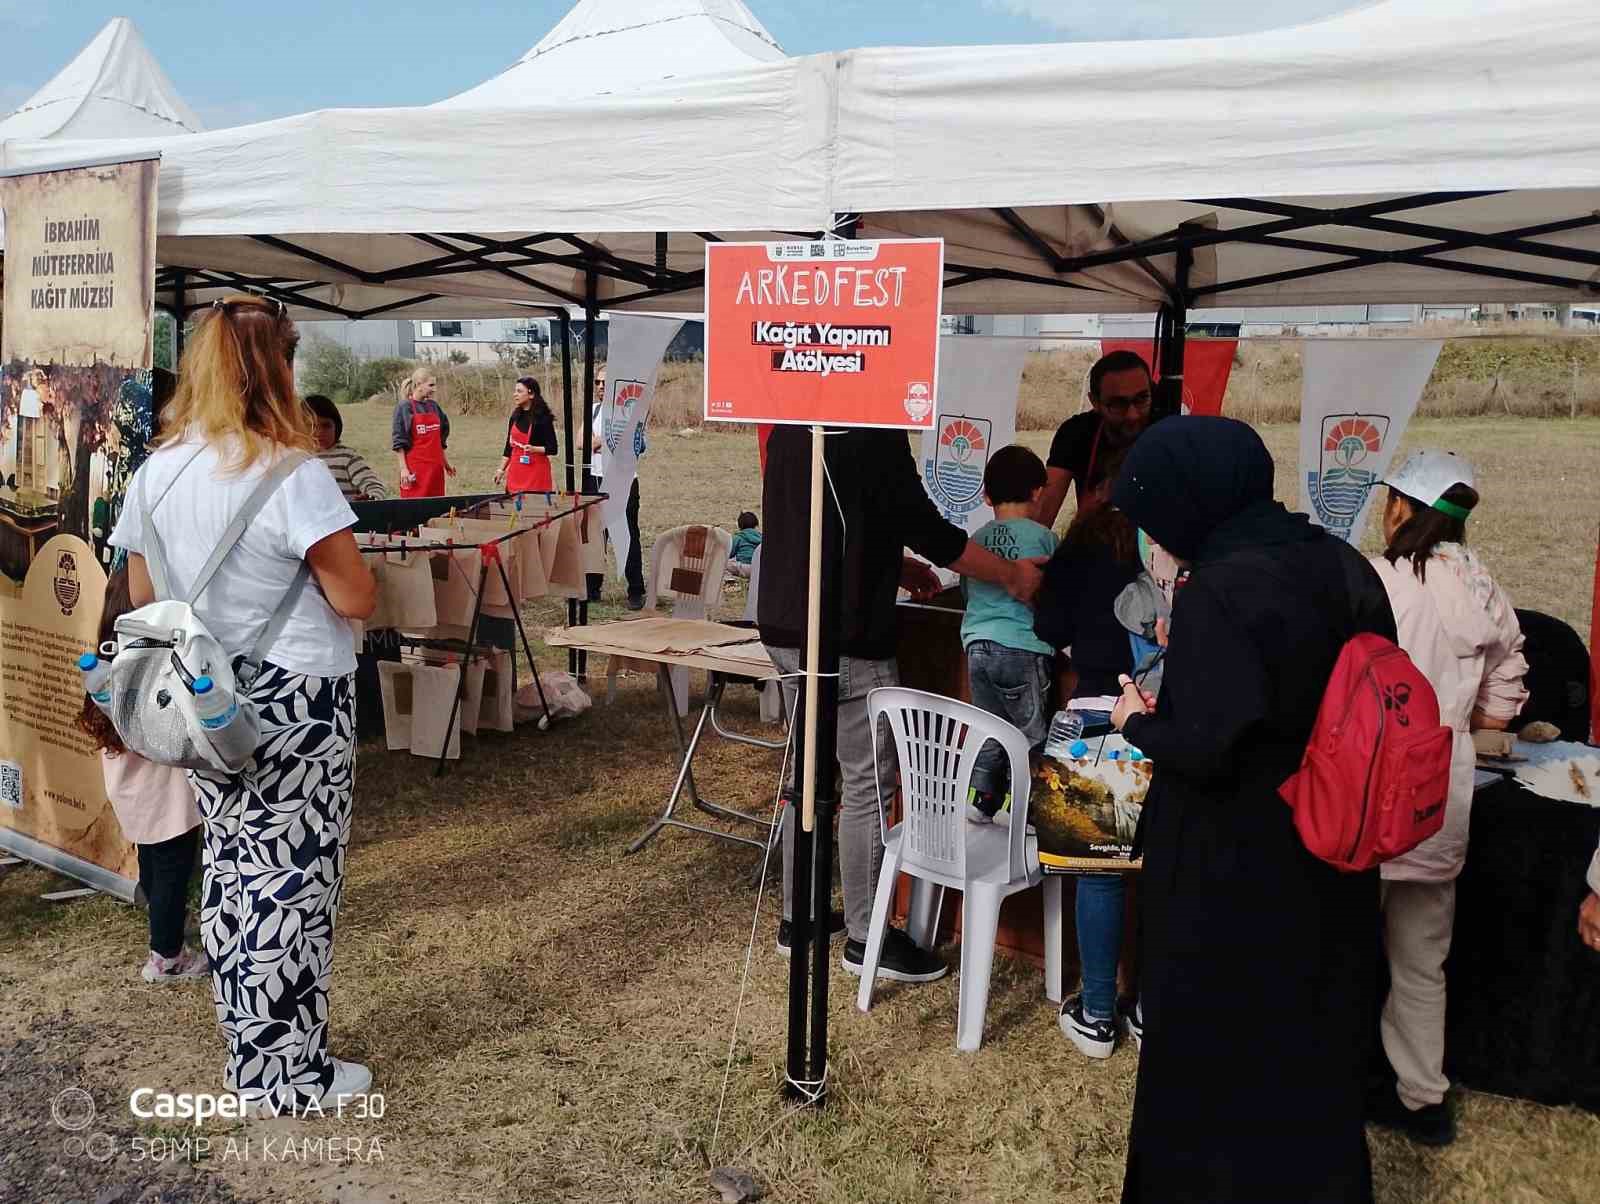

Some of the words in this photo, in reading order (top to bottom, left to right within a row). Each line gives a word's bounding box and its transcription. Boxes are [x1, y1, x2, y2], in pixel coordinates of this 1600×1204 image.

[44, 213, 100, 243] İBRAHİM
[32, 247, 114, 277] MÜTEFERRİKA
[31, 281, 66, 309] KAĞIT
[70, 280, 113, 309] MÜZESİ
[735, 264, 907, 307] ARKEOFEST
[756, 320, 812, 349] Kağıt
[816, 322, 889, 350] Yapımı
[780, 350, 862, 377] Atölyesi
[984, 535, 1017, 546] LION
[984, 546, 1020, 560] ING
